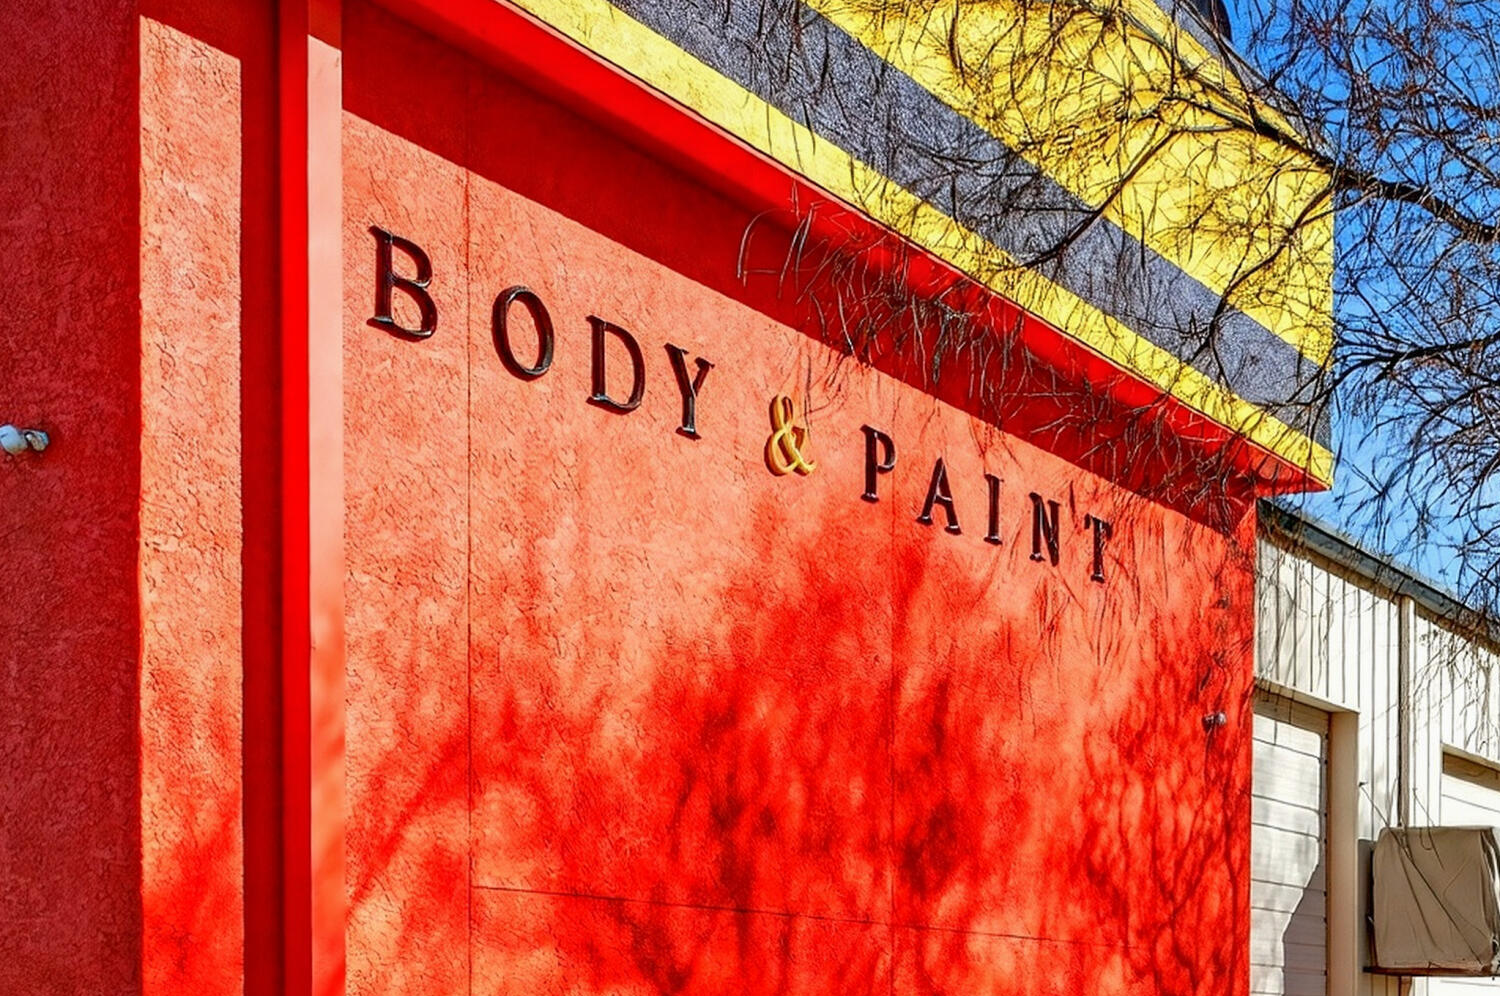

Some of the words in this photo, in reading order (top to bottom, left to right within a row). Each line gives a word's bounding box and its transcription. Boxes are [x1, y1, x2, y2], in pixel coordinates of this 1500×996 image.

[366, 225, 715, 440] BODY
[763, 394, 817, 477] &
[860, 424, 1114, 583] PAINT
